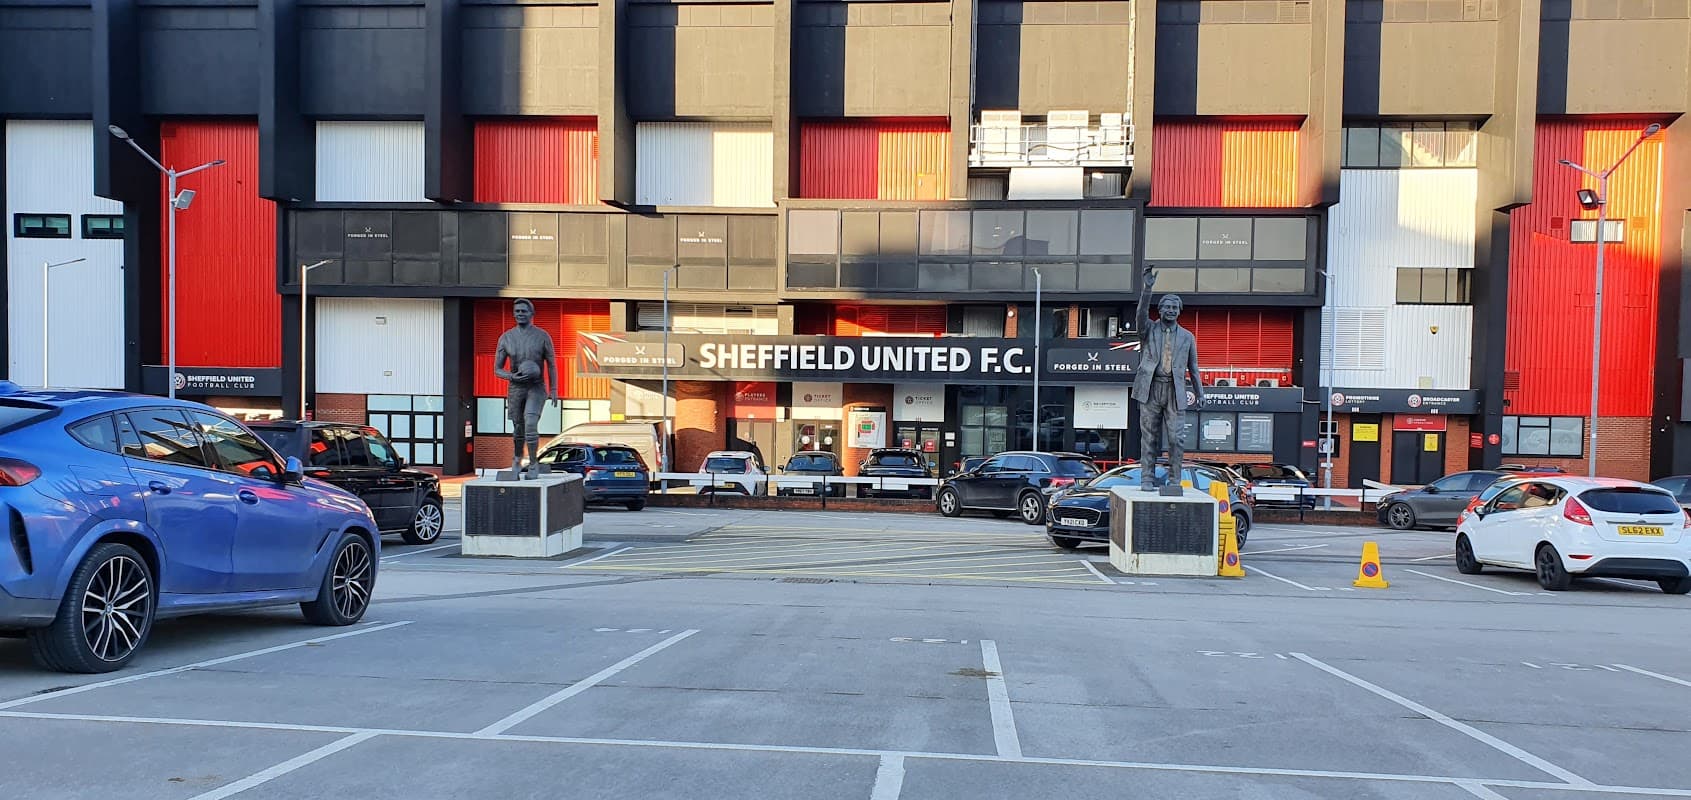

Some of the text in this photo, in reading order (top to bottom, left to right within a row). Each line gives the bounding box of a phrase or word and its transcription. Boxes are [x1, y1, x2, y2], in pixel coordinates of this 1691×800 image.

[651, 357, 676, 365] STEL
[699, 343, 1032, 373] SHEFFIELD UNITED F.C.
[1053, 363, 1089, 371] FORGED
[227, 375, 255, 383] UNITED
[1644, 527, 1661, 535] EXX
